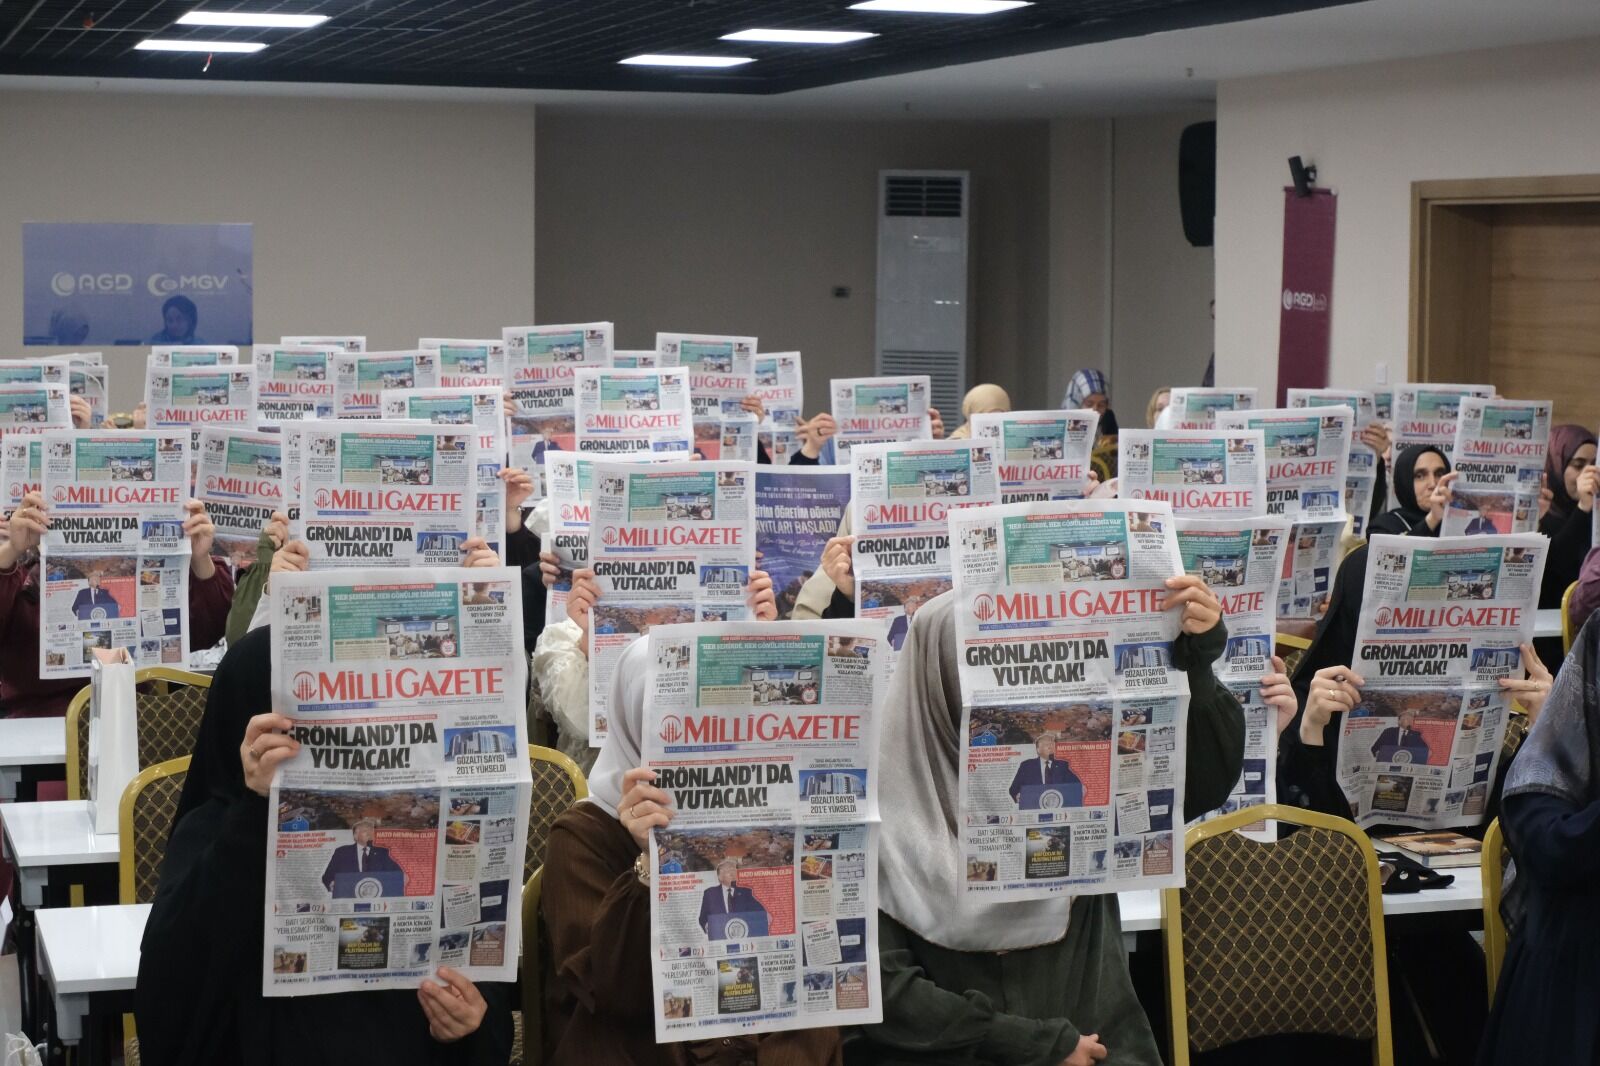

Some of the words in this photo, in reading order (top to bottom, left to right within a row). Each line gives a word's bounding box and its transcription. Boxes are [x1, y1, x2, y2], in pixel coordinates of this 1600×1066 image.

[79, 274, 133, 291] AGD
[180, 275, 229, 290] MGV
[562, 387, 574, 396] DA
[636, 440, 650, 450] DA
[1505, 463, 1517, 474] DA
[204, 503, 260, 519] RÖNLAND'I
[122, 517, 139, 530] DA
[211, 515, 262, 530] YUTACAK!
[63, 531, 122, 544] YUTACAK!
[306, 525, 391, 542] GRÖNLAND'I
[393, 527, 413, 542] DA
[325, 542, 393, 558] YUTACAK!
[857, 537, 933, 554] GRÖNLAND'I
[875, 551, 936, 567] YUTACAK!
[594, 559, 674, 576] GRÖNLAND'I
[677, 561, 696, 575] DA
[611, 576, 677, 591] YUTACAK!
[966, 641, 1080, 667] GRÖNLAND'I
[1083, 638, 1109, 660] DA
[1360, 643, 1448, 661] GRÖNLAND'I
[1450, 643, 1468, 659] DA
[992, 662, 1085, 687] YUTACAK!
[1379, 660, 1448, 676] YUTACAK!
[410, 722, 438, 744] DA
[310, 747, 411, 771] YUTACAK!
[650, 766, 763, 789] GRÖNLAND'I
[766, 763, 794, 784] DA
[674, 786, 769, 810] YUTACAK!
